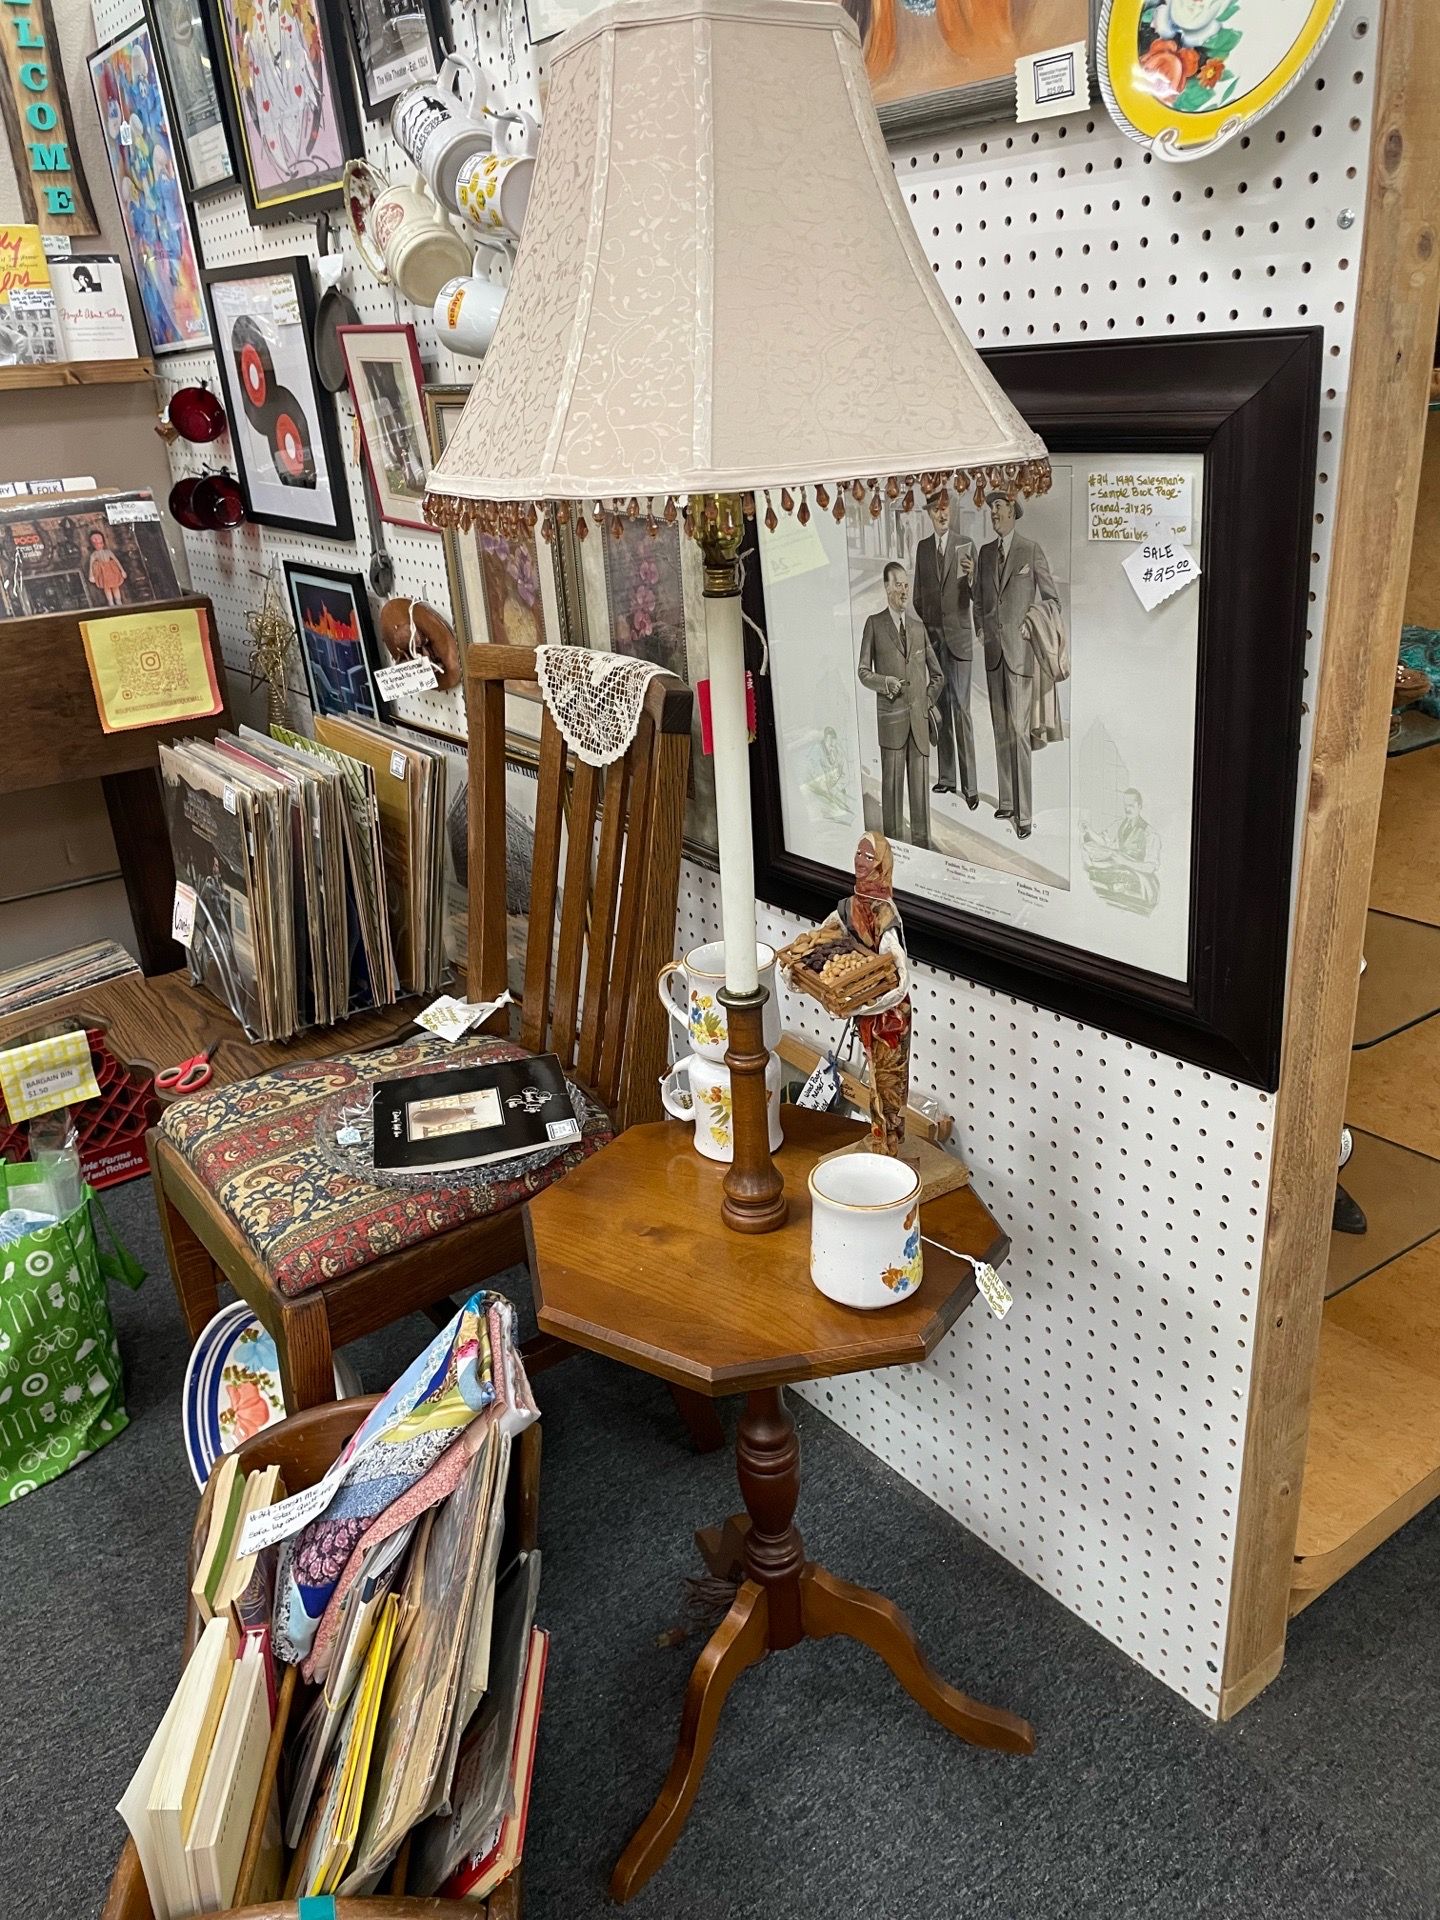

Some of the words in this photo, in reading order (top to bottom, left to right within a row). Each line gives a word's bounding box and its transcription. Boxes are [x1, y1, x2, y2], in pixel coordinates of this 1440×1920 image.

[37, 485, 59, 495] FOLK
[1132, 487, 1154, 497] Book
[1143, 544, 1174, 560] SALE
[26, 1075, 59, 1088] BARGAIN
[60, 1070, 73, 1079] BIN
[28, 1086, 49, 1098] $1.50
[98, 1151, 132, 1167] Farms
[105, 1157, 144, 1174] Roberts
